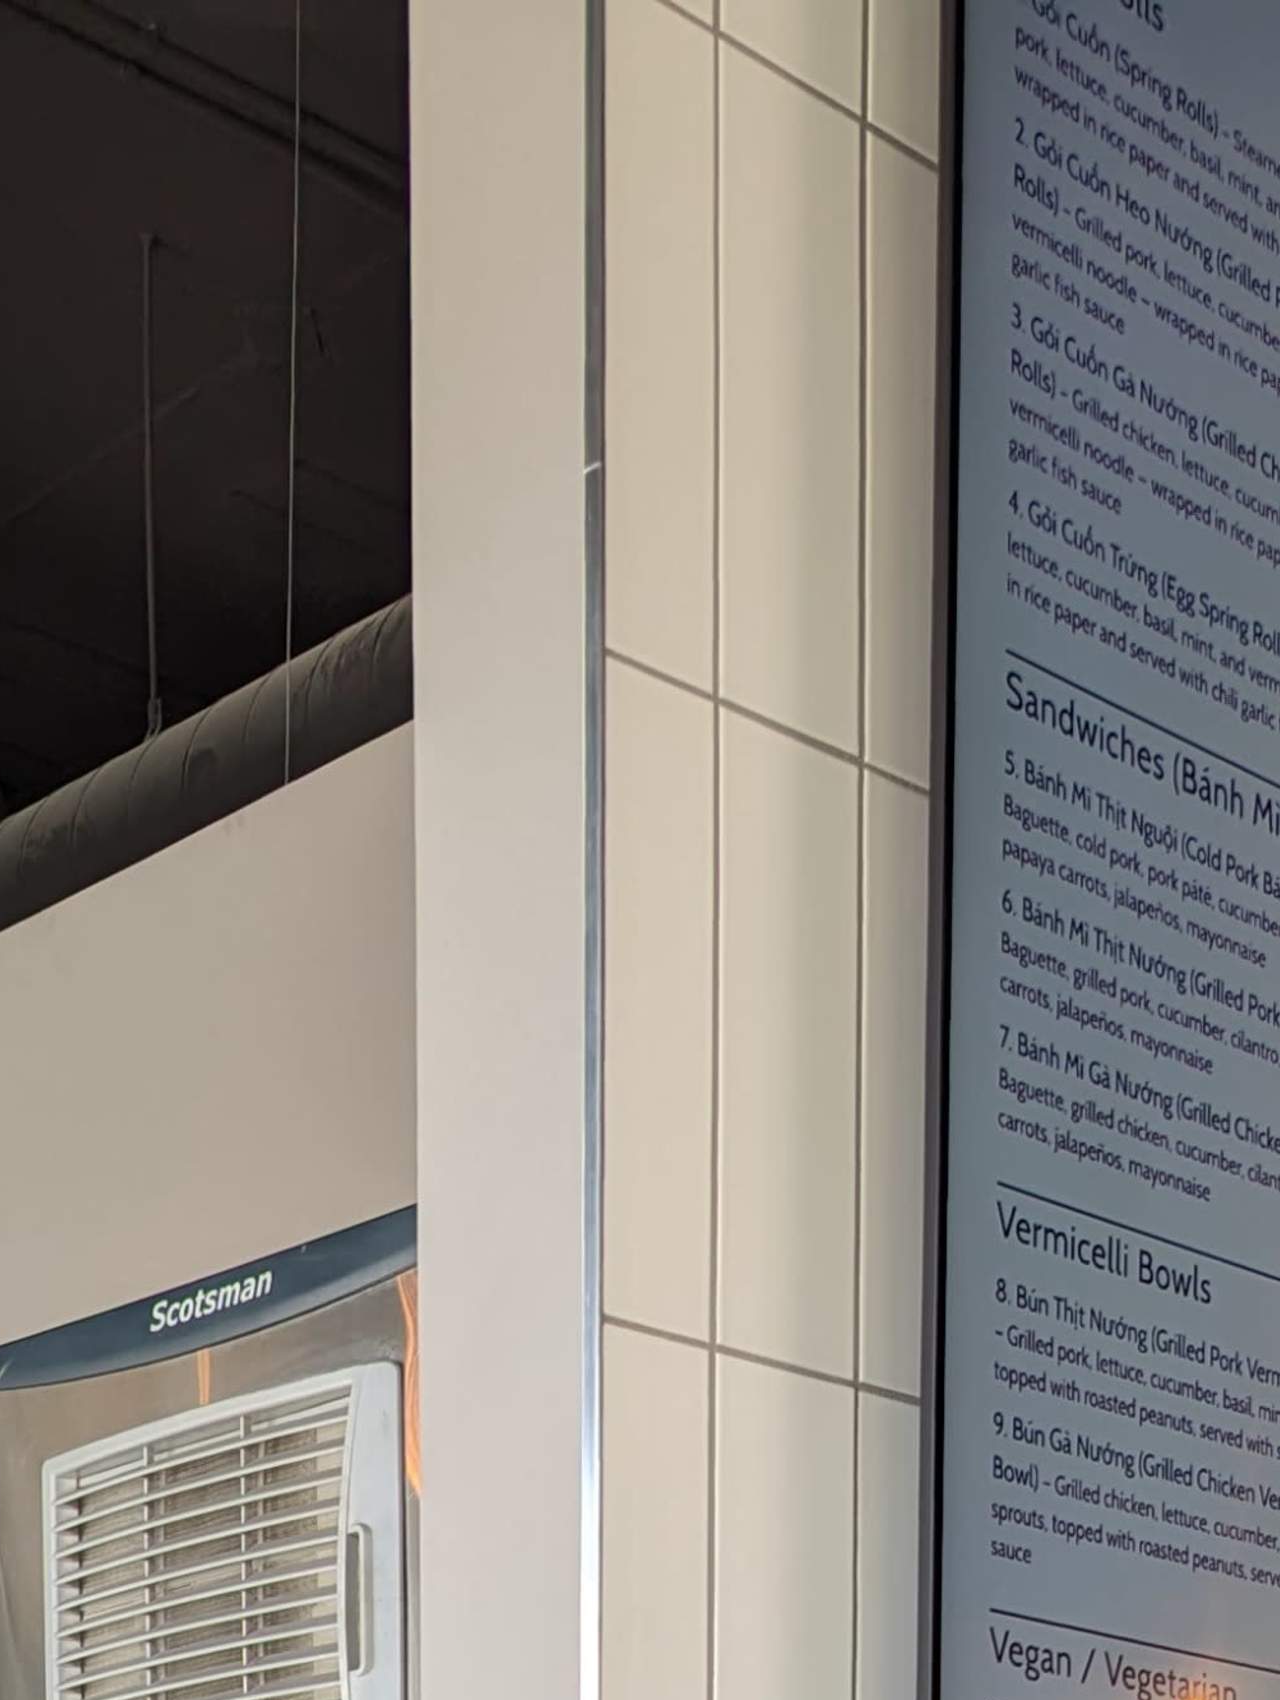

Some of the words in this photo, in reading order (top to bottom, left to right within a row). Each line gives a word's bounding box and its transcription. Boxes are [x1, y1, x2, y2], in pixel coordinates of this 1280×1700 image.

[1014, 115, 1029, 149] 2.
[1114, 182, 1151, 226] Heo
[1215, 246, 1272, 303] (Grilled
[1005, 669, 1165, 782] Sandwiches
[1172, 750, 1245, 820] (Bánh
[1004, 748, 1020, 780] 5.
[1023, 757, 1068, 802] Bánh
[1180, 831, 1223, 873] (Cold
[1224, 852, 1260, 891] Pork
[1001, 837, 1056, 878] papaya
[1185, 919, 1267, 969] mayonnaise
[1069, 1098, 1116, 1131] grilled
[150, 1270, 272, 1333] Scotsman
[996, 1199, 1129, 1278] Vermicelli
[1138, 1247, 1212, 1305] Bowls
[994, 1276, 1011, 1306] 8.
[1015, 1283, 1050, 1317] Bún
[1150, 1324, 1206, 1365] (Grilled
[1208, 1344, 1244, 1377] Pork
[993, 1360, 1047, 1394] topped
[1049, 1377, 1081, 1404] with
[1083, 1389, 1137, 1419] roasted
[1198, 1422, 1244, 1450] served
[1245, 1434, 1274, 1458] with
[988, 1625, 1072, 1683] Vegan
[1080, 1647, 1097, 1685] /
